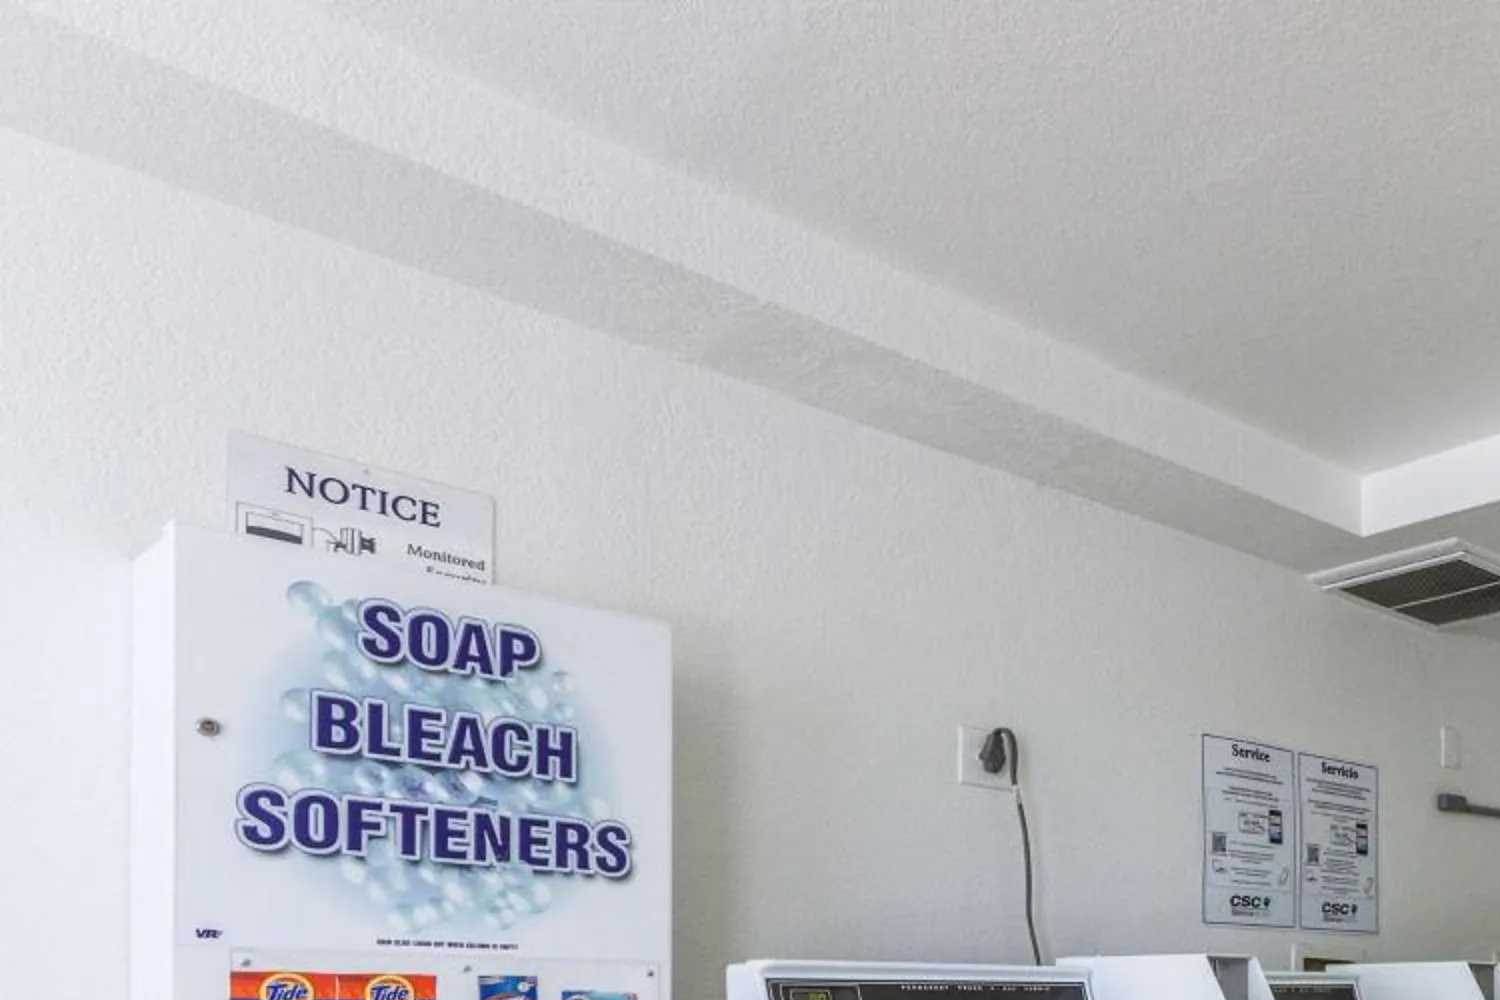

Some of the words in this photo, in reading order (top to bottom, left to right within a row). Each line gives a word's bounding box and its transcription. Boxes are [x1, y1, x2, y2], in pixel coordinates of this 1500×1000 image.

[285, 466, 441, 528] NOTICE
[407, 543, 486, 571] Monitored
[360, 602, 540, 679] SOAP
[312, 690, 579, 781] BLEACH
[1231, 744, 1271, 763] Service
[1321, 761, 1359, 779] Servicio
[238, 784, 632, 876] SOFTENERS
[1229, 895, 1261, 908] CSC
[1321, 902, 1350, 915] CSC
